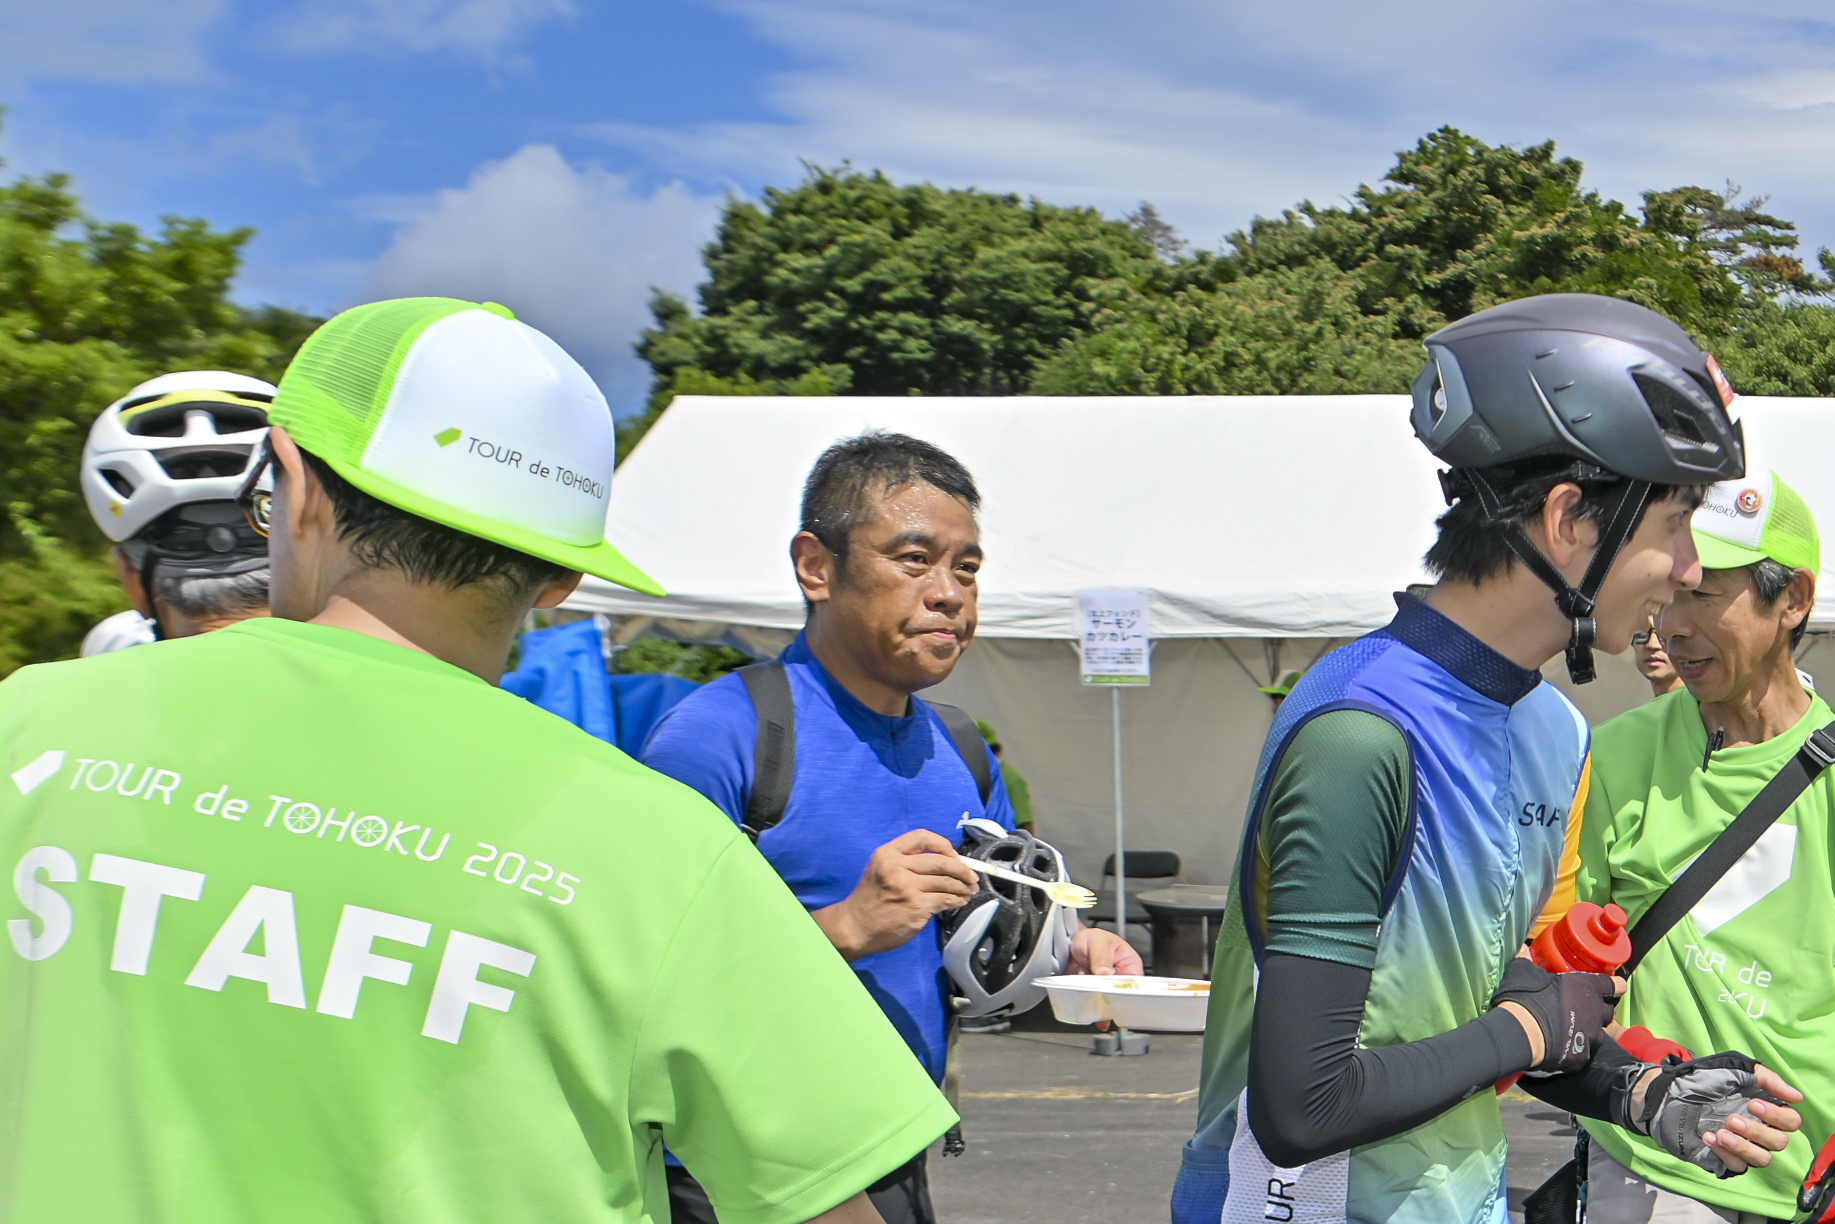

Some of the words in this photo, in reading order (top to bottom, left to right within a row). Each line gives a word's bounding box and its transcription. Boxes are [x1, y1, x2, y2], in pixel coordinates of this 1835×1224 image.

[469, 437, 523, 468] TOUR
[529, 460, 550, 478] de
[556, 466, 604, 499] TOHOKU
[1086, 631, 1142, 642] カツカレー
[1091, 618, 1136, 629] サーモン
[68, 758, 181, 804] TOUR
[194, 785, 249, 821] de
[263, 795, 451, 862] TOHOKU
[463, 842, 581, 905] 2025
[7, 845, 537, 1044] STAFF
[1737, 960, 1772, 988] de
